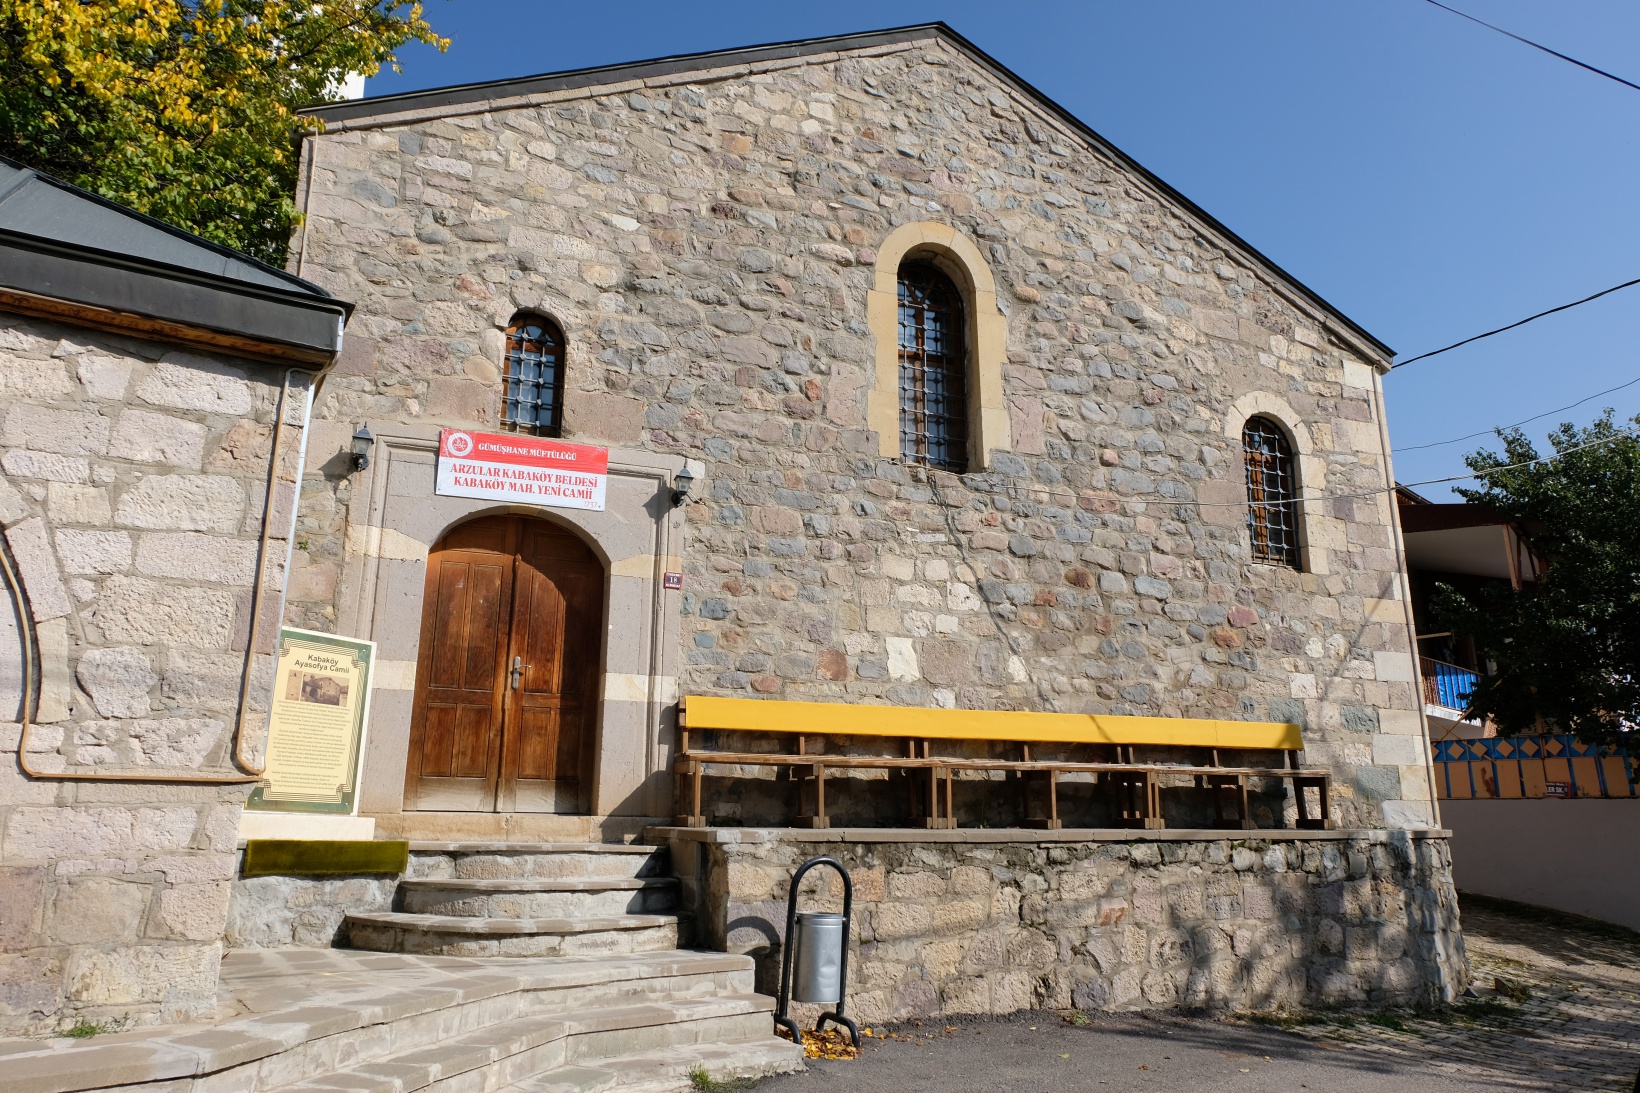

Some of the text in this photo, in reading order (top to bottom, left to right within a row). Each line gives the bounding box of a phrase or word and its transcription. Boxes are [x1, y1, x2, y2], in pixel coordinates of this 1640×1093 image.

[478, 442, 577, 460] GÜMÜŞHANE MÜFTÜLÜĞÜ
[450, 463, 598, 487] ARZULAR KABAKÖY BELDESİ
[453, 476, 593, 499] KABAKÖY MAH. YENİ CAMİİ
[294, 659, 328, 671] Ayasofya
[308, 654, 339, 666] Kabaköy
